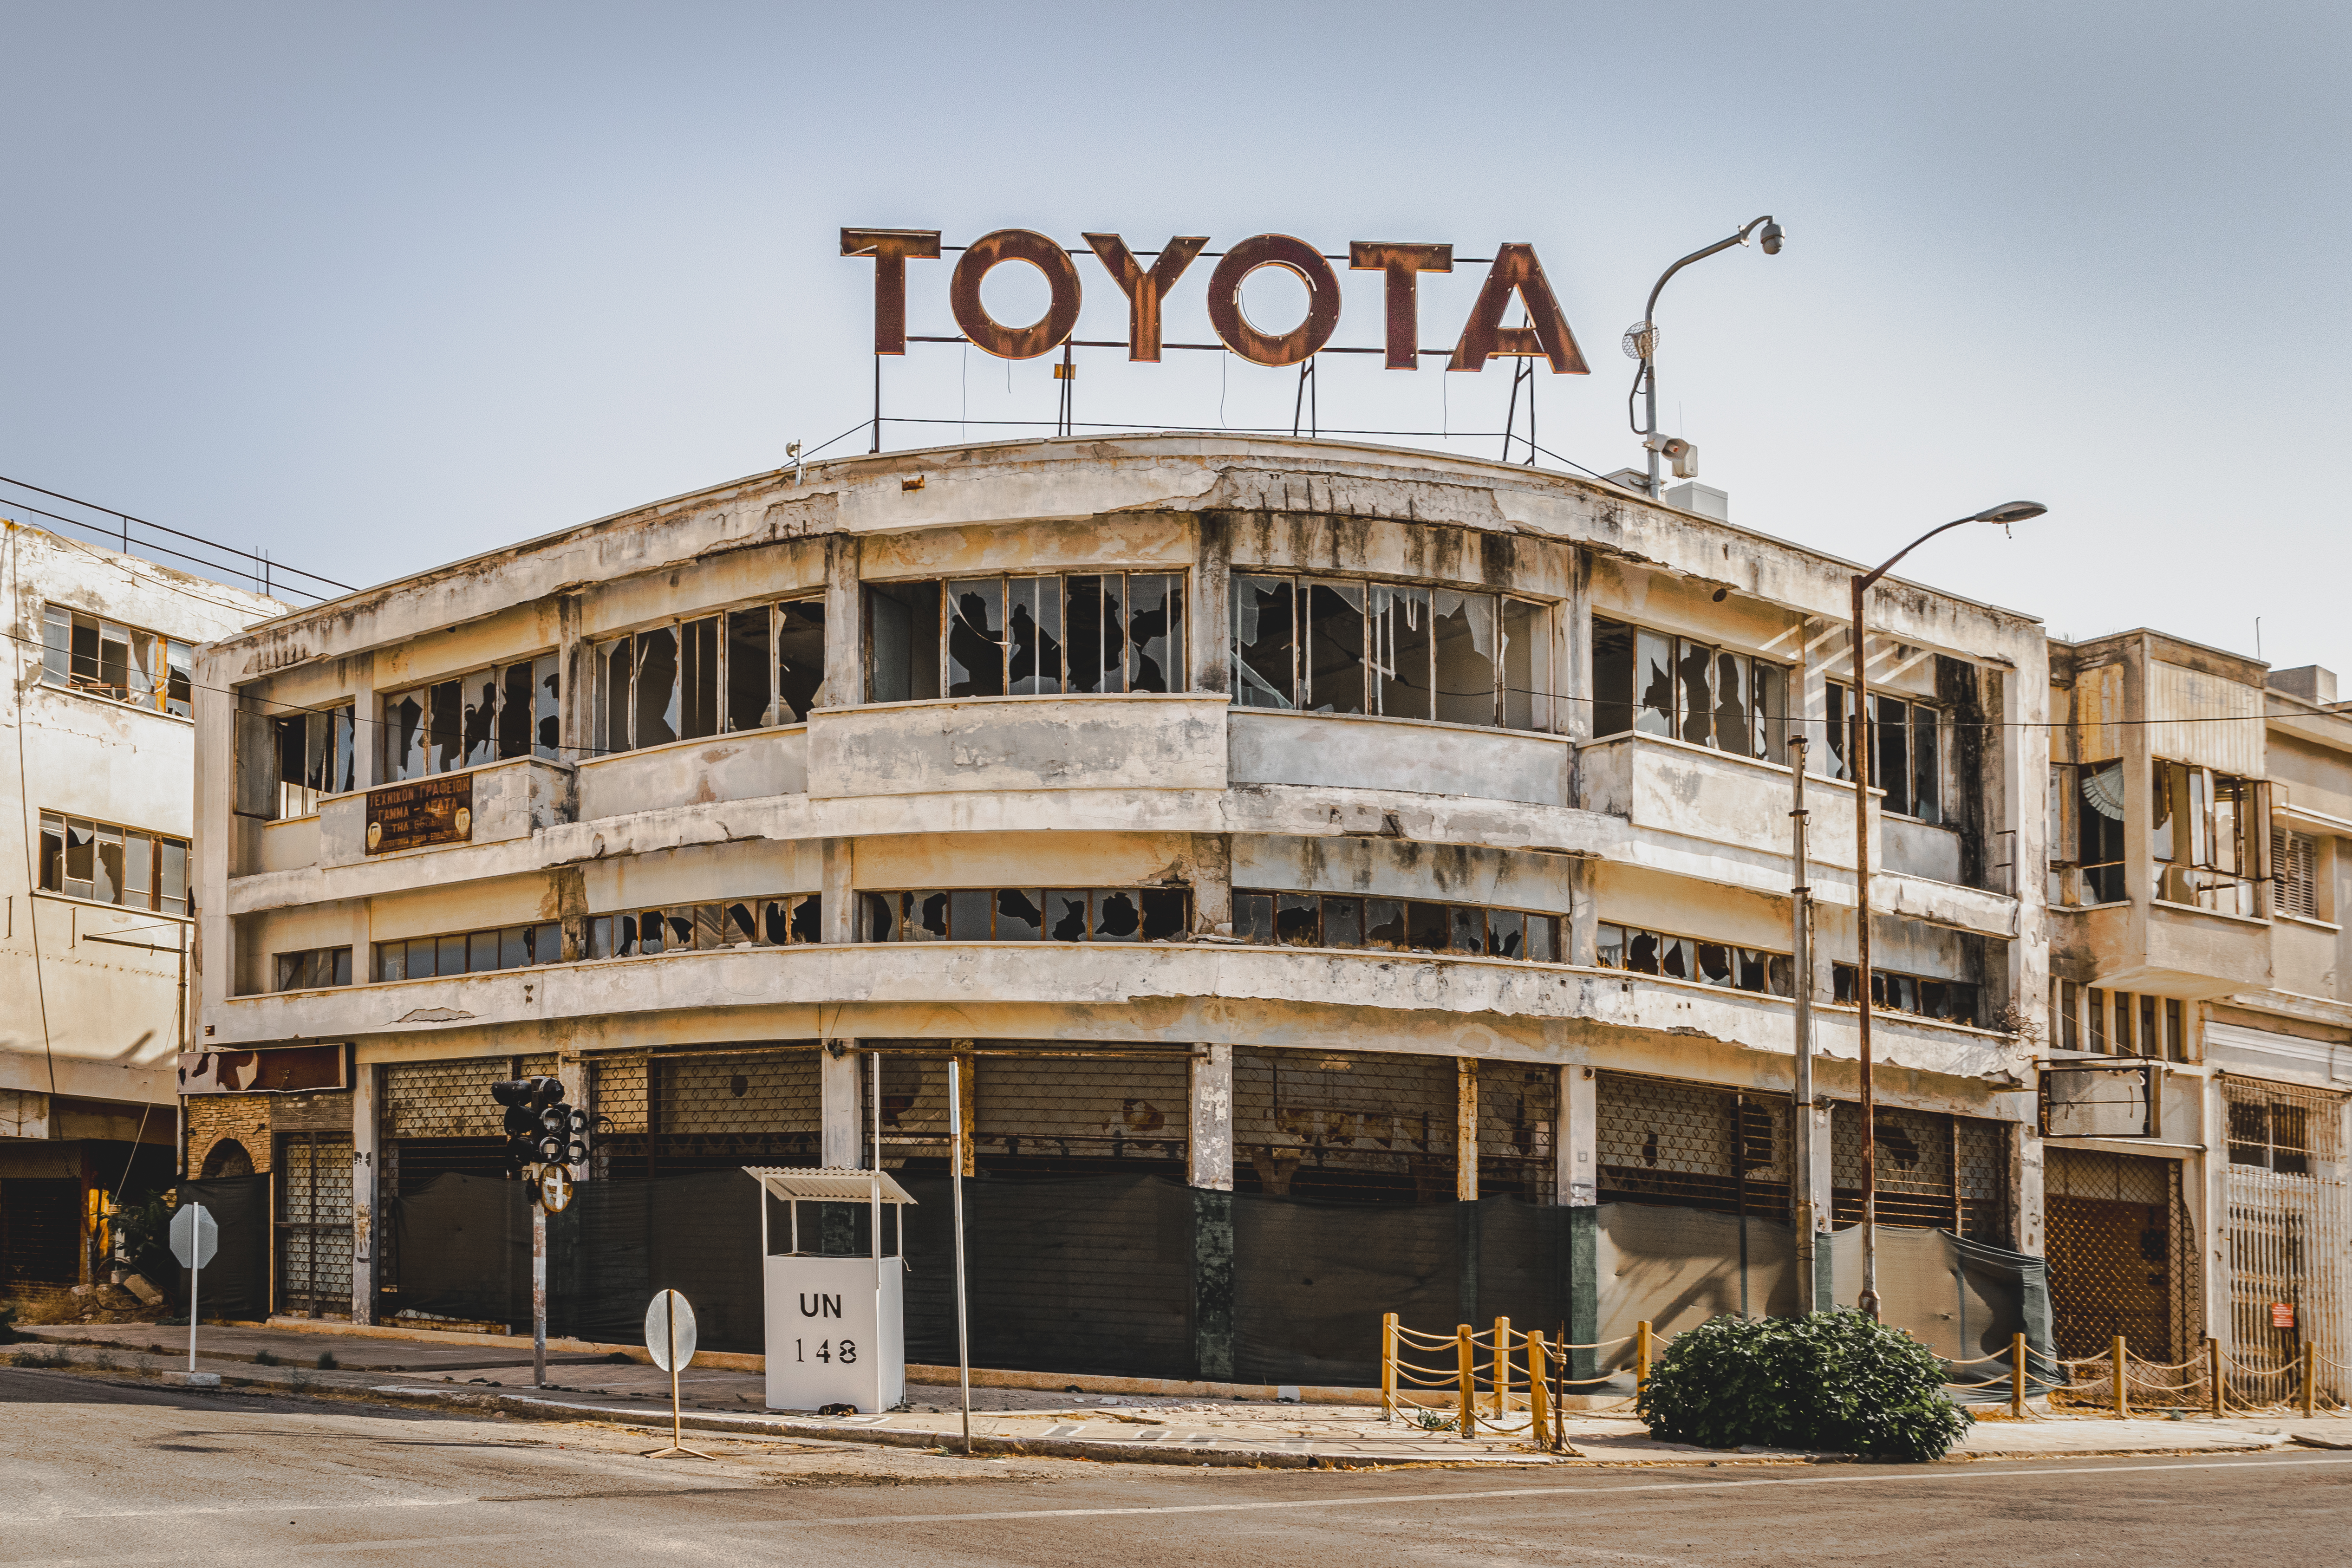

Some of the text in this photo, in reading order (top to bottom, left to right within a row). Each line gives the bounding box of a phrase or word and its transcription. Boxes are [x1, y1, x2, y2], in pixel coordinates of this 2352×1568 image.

[840, 227, 1591, 374] TOYOTA
[369, 778, 470, 807] ΤΕΧΝΙΚΟΝ ΓΡΑΦΕΙΟΝ
[378, 806, 409, 822] ΓΑΜΜΑ
[800, 1293, 841, 1318] UN
[795, 1338, 857, 1364] 148
